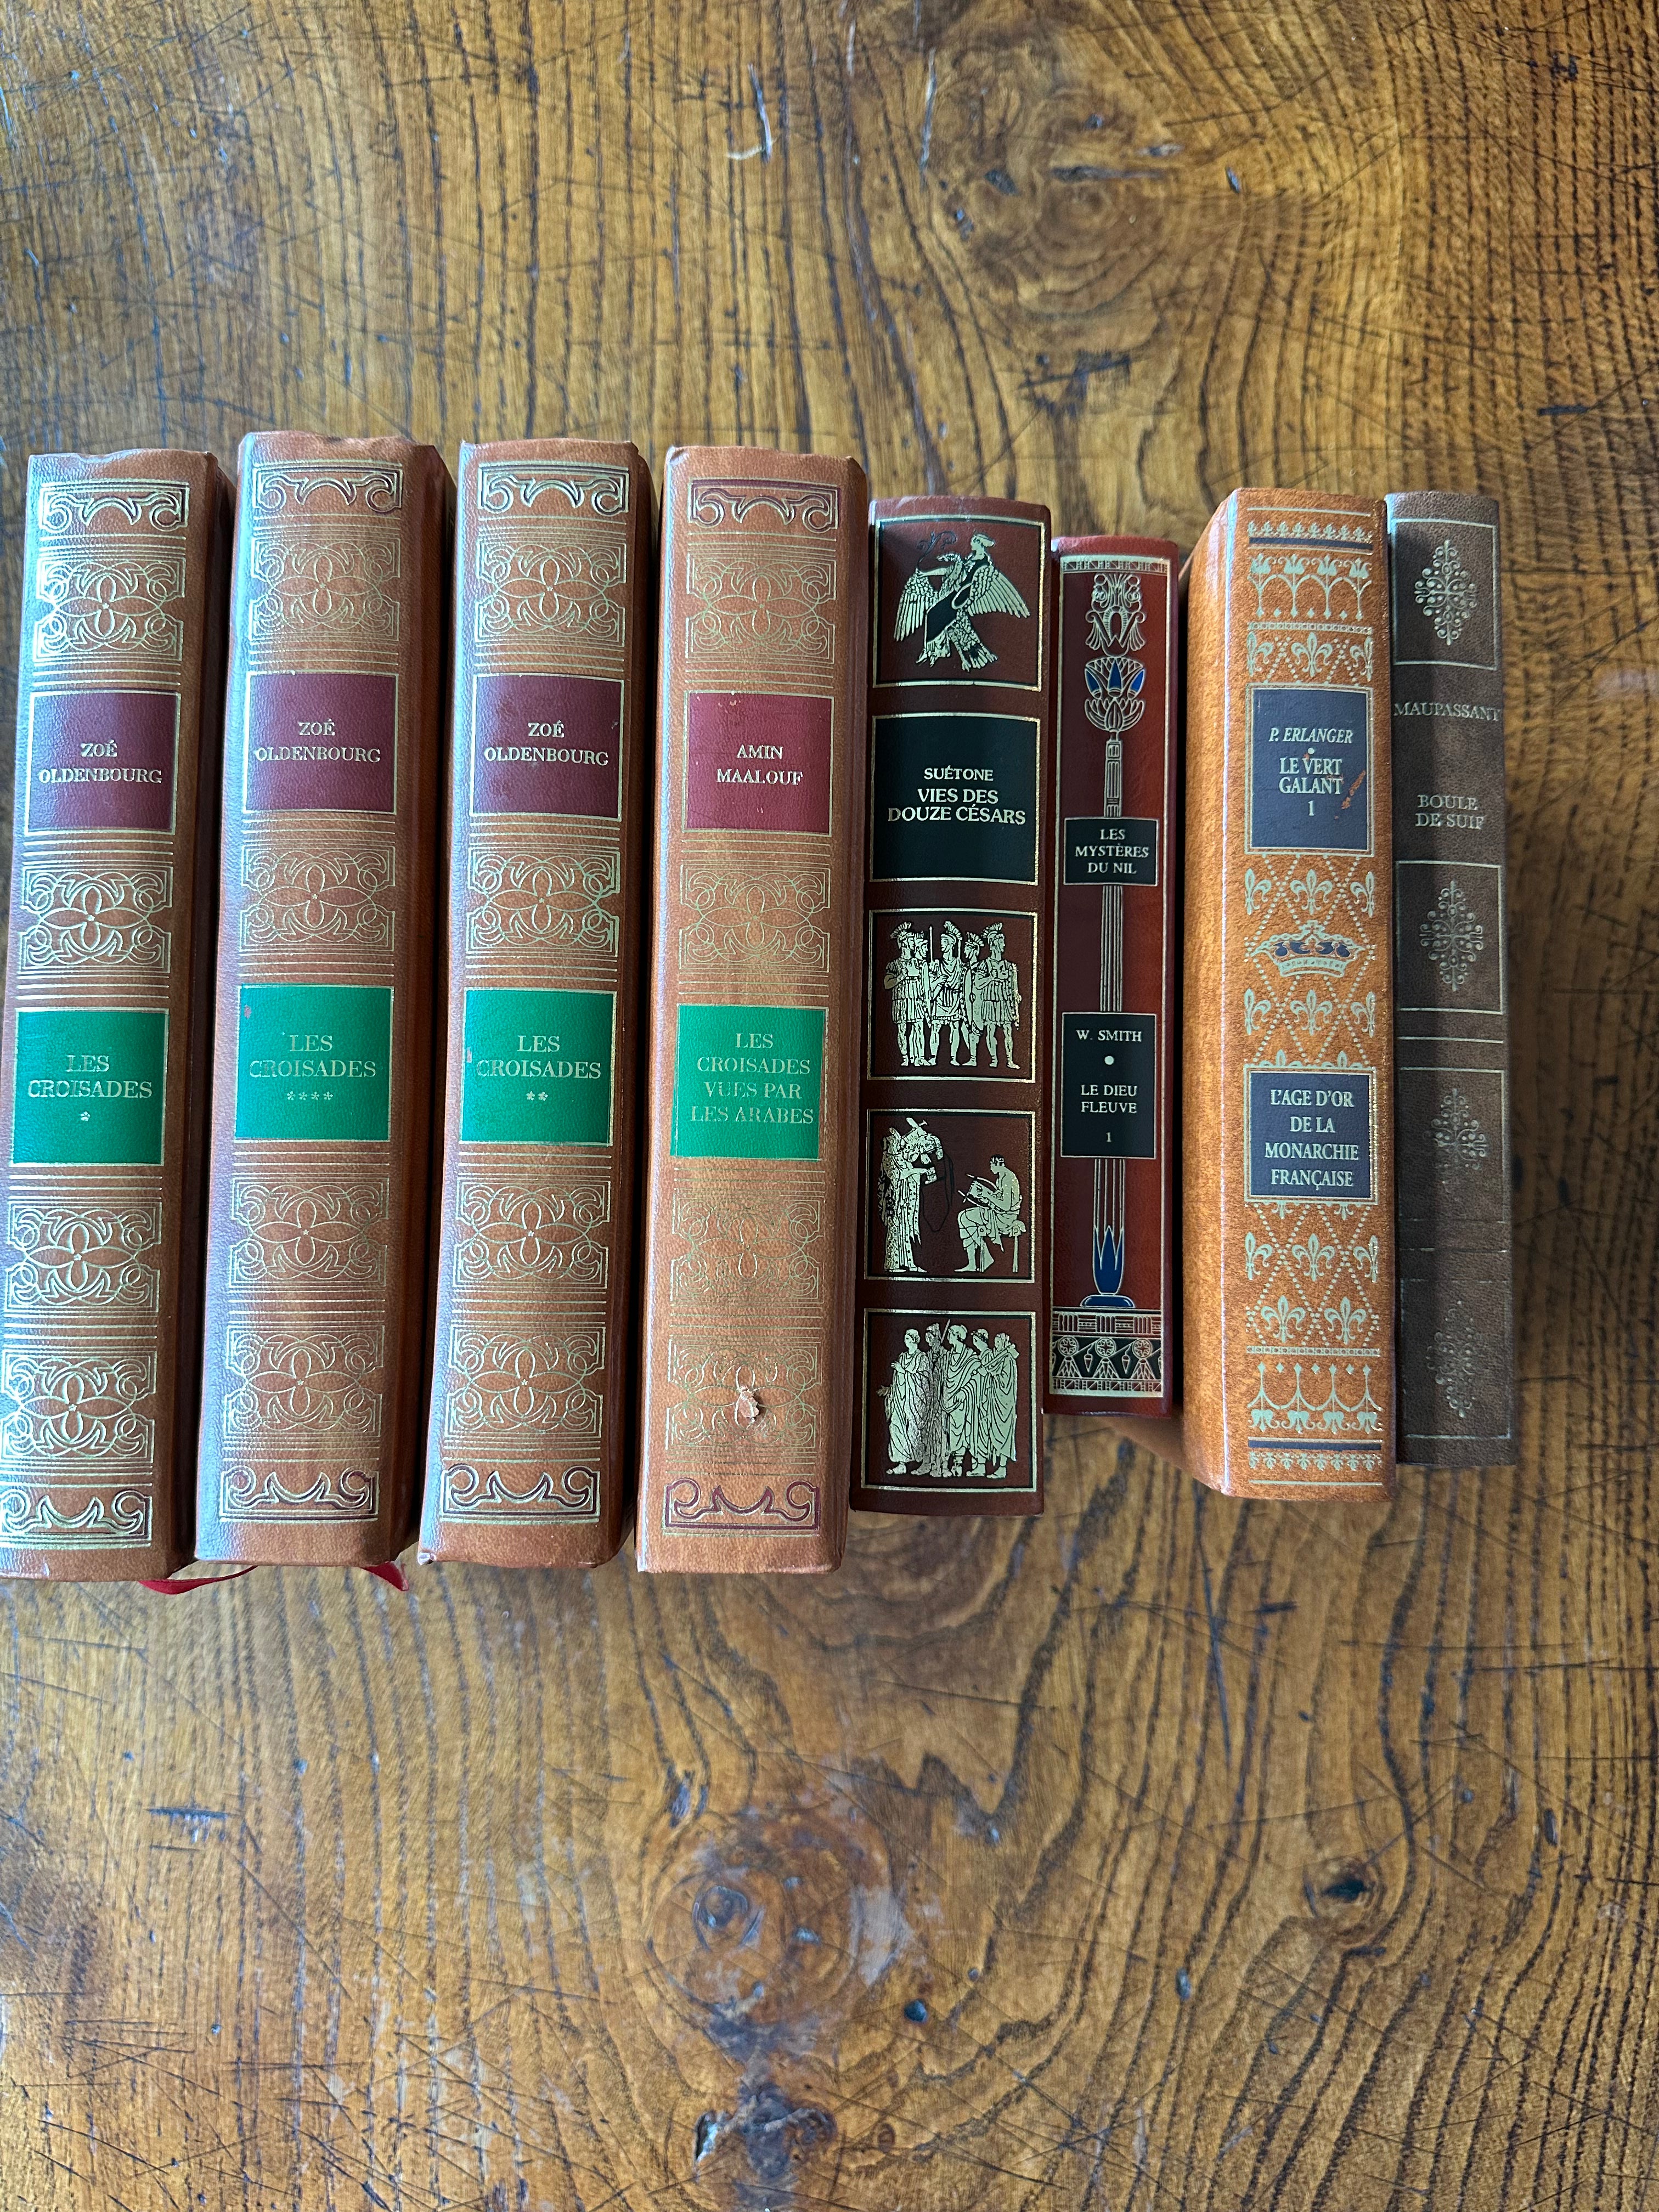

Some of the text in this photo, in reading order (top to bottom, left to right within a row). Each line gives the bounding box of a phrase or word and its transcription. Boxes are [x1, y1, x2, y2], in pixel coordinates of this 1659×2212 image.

[1393, 702, 1502, 722] MAUPASSANT
[298, 718, 335, 737] ZOÉ
[528, 720, 565, 738] ZOÉ
[1268, 727, 1353, 744] P. ERLANGER
[81, 739, 117, 758] ZOÉ
[254, 746, 381, 764] OLDENBOURG
[484, 747, 609, 766] OLDENBOURG
[737, 744, 783, 760] AMIN
[924, 765, 994, 781] SUÉTONE
[1279, 757, 1342, 776] LE VERT
[38, 768, 162, 785] OLDENBOURG
[716, 769, 804, 786] MAALOUF
[1279, 776, 1343, 794] GALANT
[917, 788, 998, 804] VIES DES
[1418, 794, 1478, 811] BOULE
[888, 803, 1026, 825] DOUZE CÉSARS
[1307, 800, 1314, 816] 1
[1415, 812, 1485, 830] DE SUIF
[1100, 829, 1125, 840] LES
[1075, 843, 1149, 858] MYSTÈRES
[1087, 862, 1137, 874] DU NIL
[289, 1035, 334, 1052] LES
[516, 1035, 561, 1053] LES
[736, 1033, 774, 1049] LES
[1098, 1030, 1142, 1042] SMITH
[65, 1054, 110, 1073] LES
[249, 1060, 377, 1078] CROISADES
[476, 1060, 602, 1080] CROISADES
[697, 1057, 811, 1075] CROISADES
[27, 1080, 153, 1099] CROISADES
[704, 1081, 802, 1099] VUES PAR
[1081, 1085, 1137, 1097] LE DIEU
[691, 1105, 815, 1125] LES ARABES
[1081, 1102, 1137, 1114] FLEUVE
[1290, 1116, 1336, 1133] DE LA
[1105, 1132, 1112, 1143] 1
[1265, 1142, 1359, 1161] MONARCHIE
[1271, 1169, 1353, 1190] FRANÇAISE
